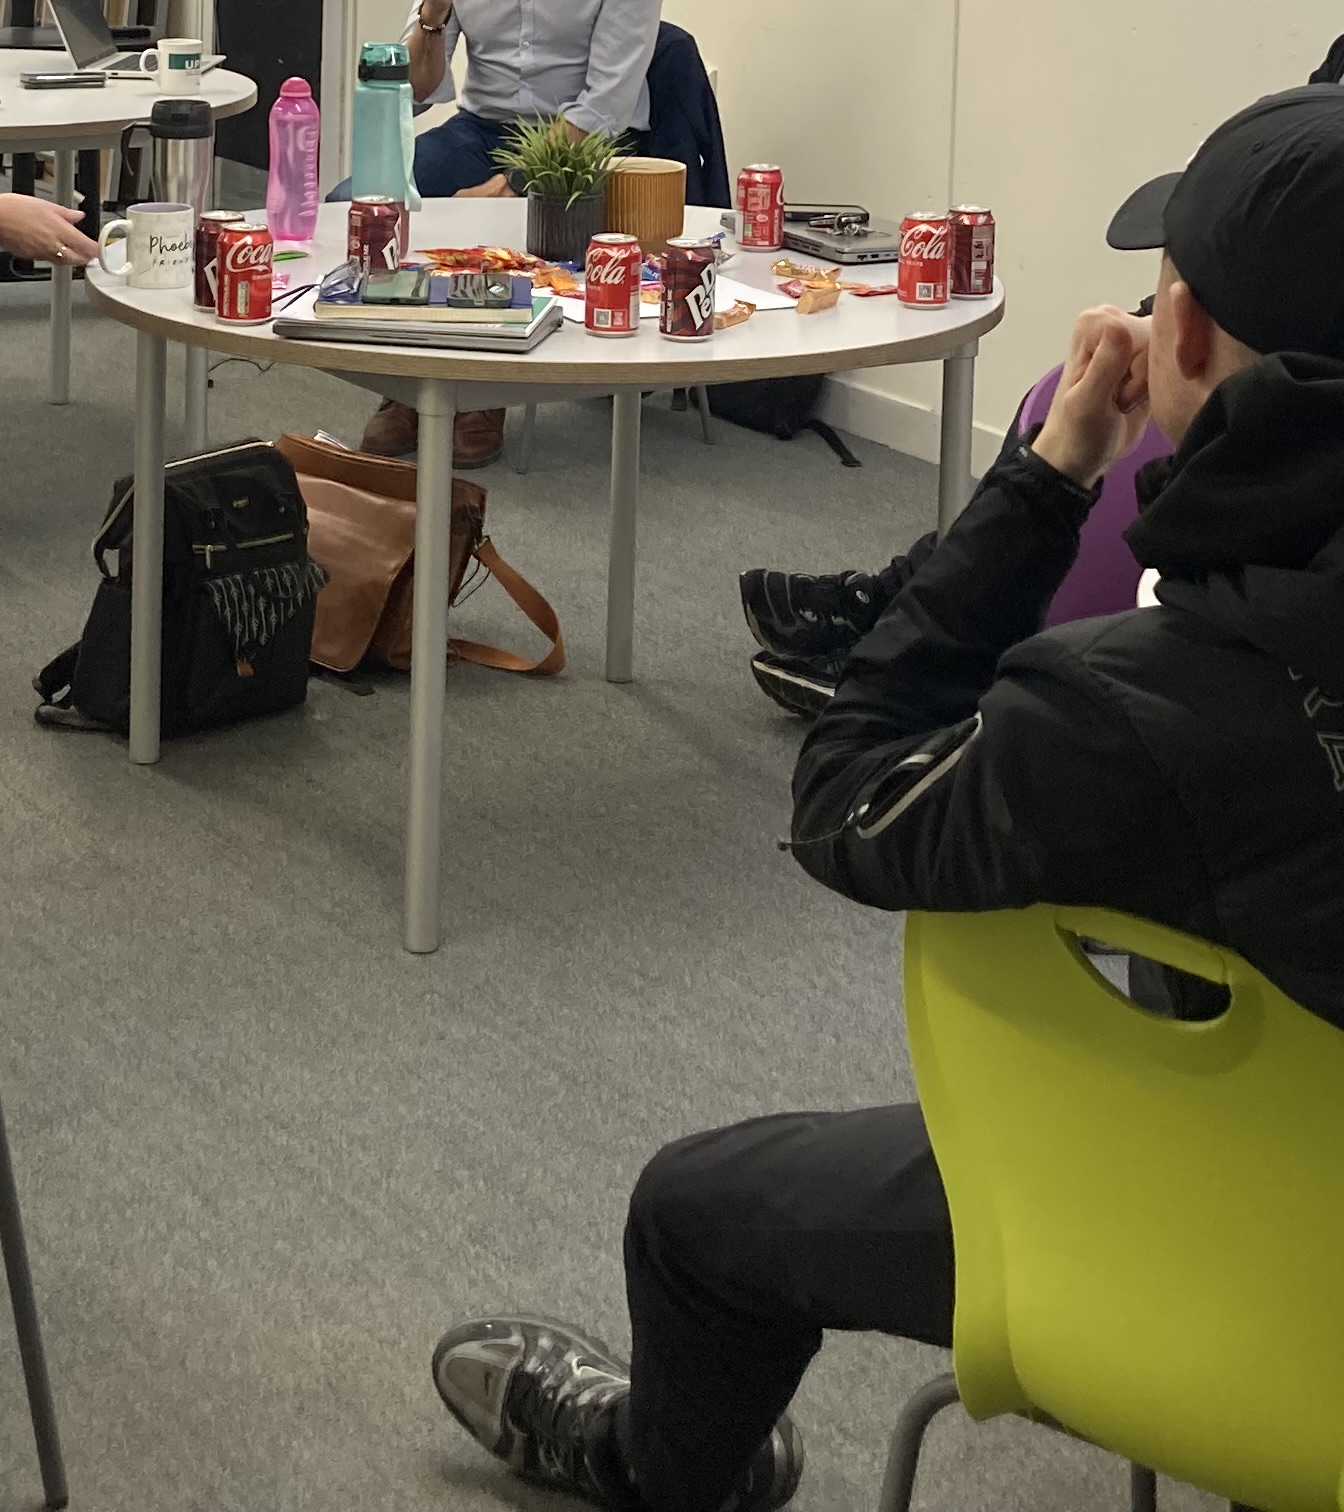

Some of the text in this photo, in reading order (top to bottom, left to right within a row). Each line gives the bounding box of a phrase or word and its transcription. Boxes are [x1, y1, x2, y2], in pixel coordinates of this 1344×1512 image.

[226, 235, 274, 273] Coca
[901, 223, 948, 259] Cola
[585, 247, 631, 285] Cola
